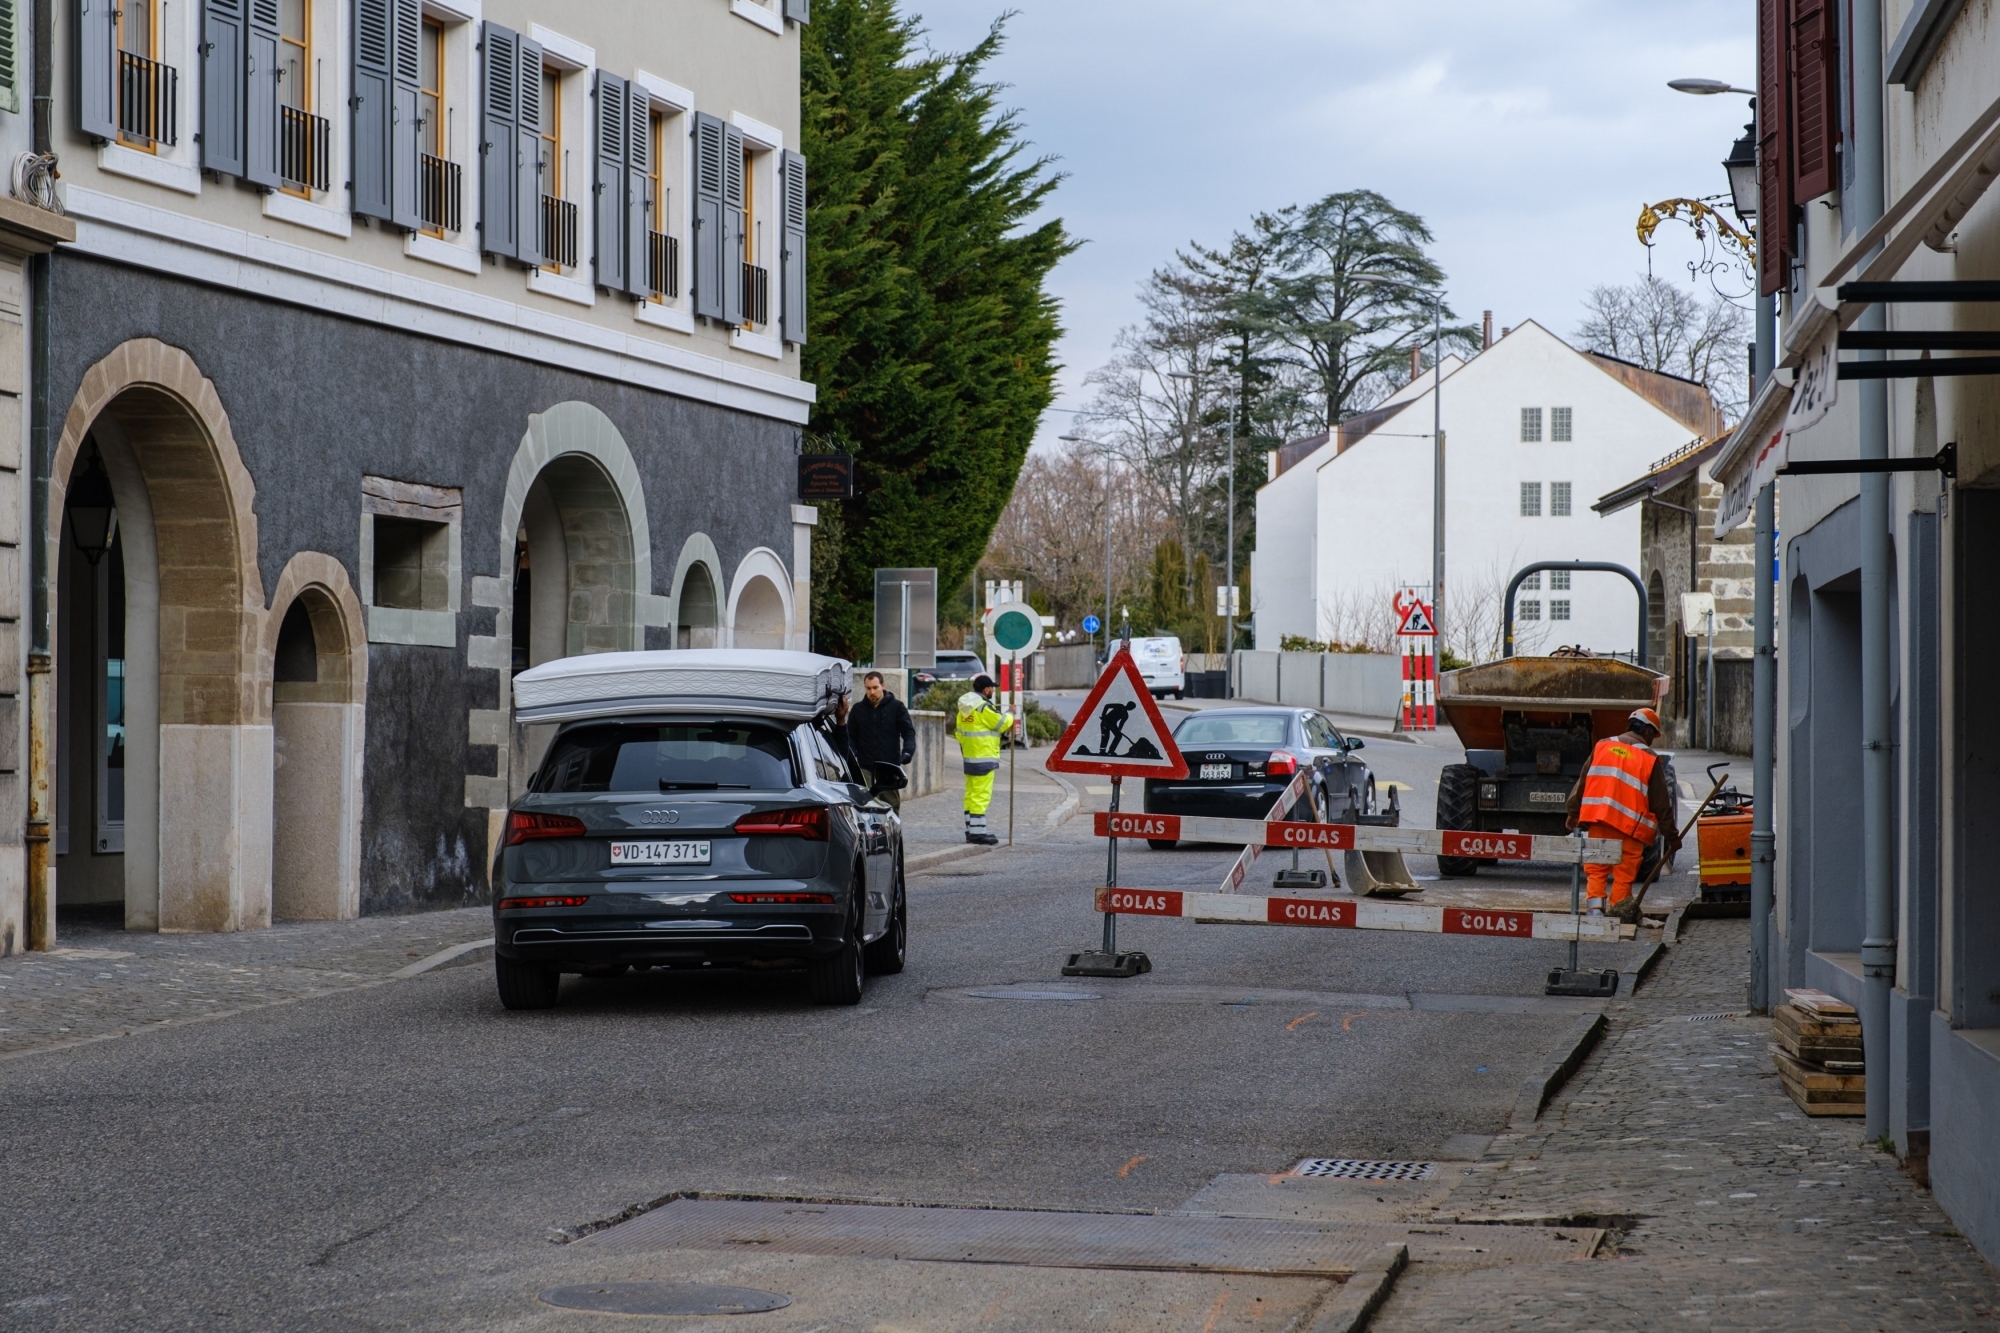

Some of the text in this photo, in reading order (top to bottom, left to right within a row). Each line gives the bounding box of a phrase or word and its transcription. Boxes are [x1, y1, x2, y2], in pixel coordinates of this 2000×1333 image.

[1110, 817, 1165, 834] COLAS
[1284, 827, 1340, 844] COLAS
[1460, 838, 1517, 855] COLAS
[1111, 894, 1167, 911] COLAS
[1285, 904, 1341, 921] COLAS
[1461, 915, 1518, 932] COLAS
